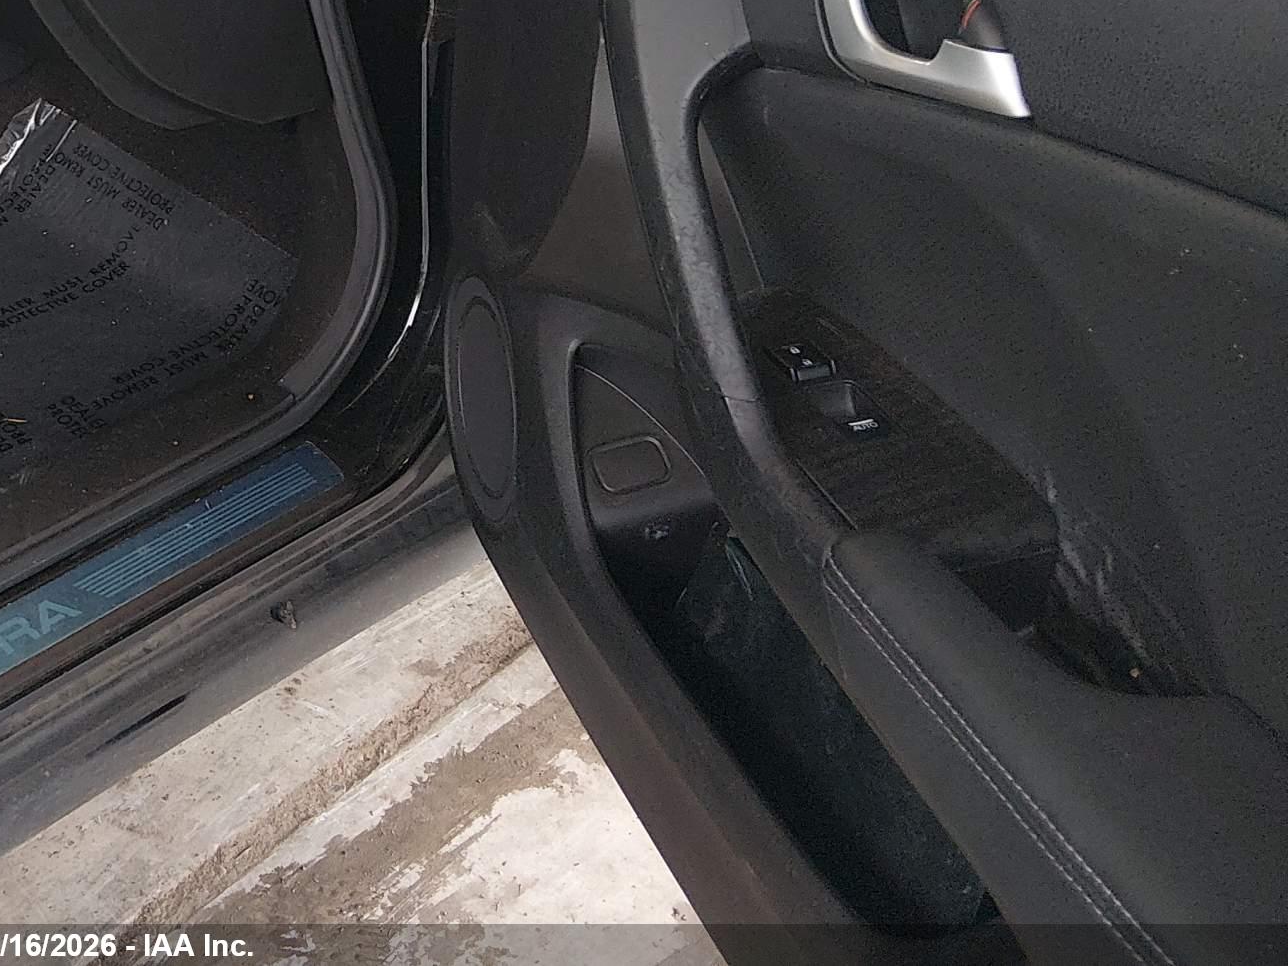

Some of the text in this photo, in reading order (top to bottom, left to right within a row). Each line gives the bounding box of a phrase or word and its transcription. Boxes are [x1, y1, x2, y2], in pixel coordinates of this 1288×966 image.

[72, 141, 111, 172] COVER
[41, 275, 85, 298] MUST
[82, 260, 131, 294] COVER
